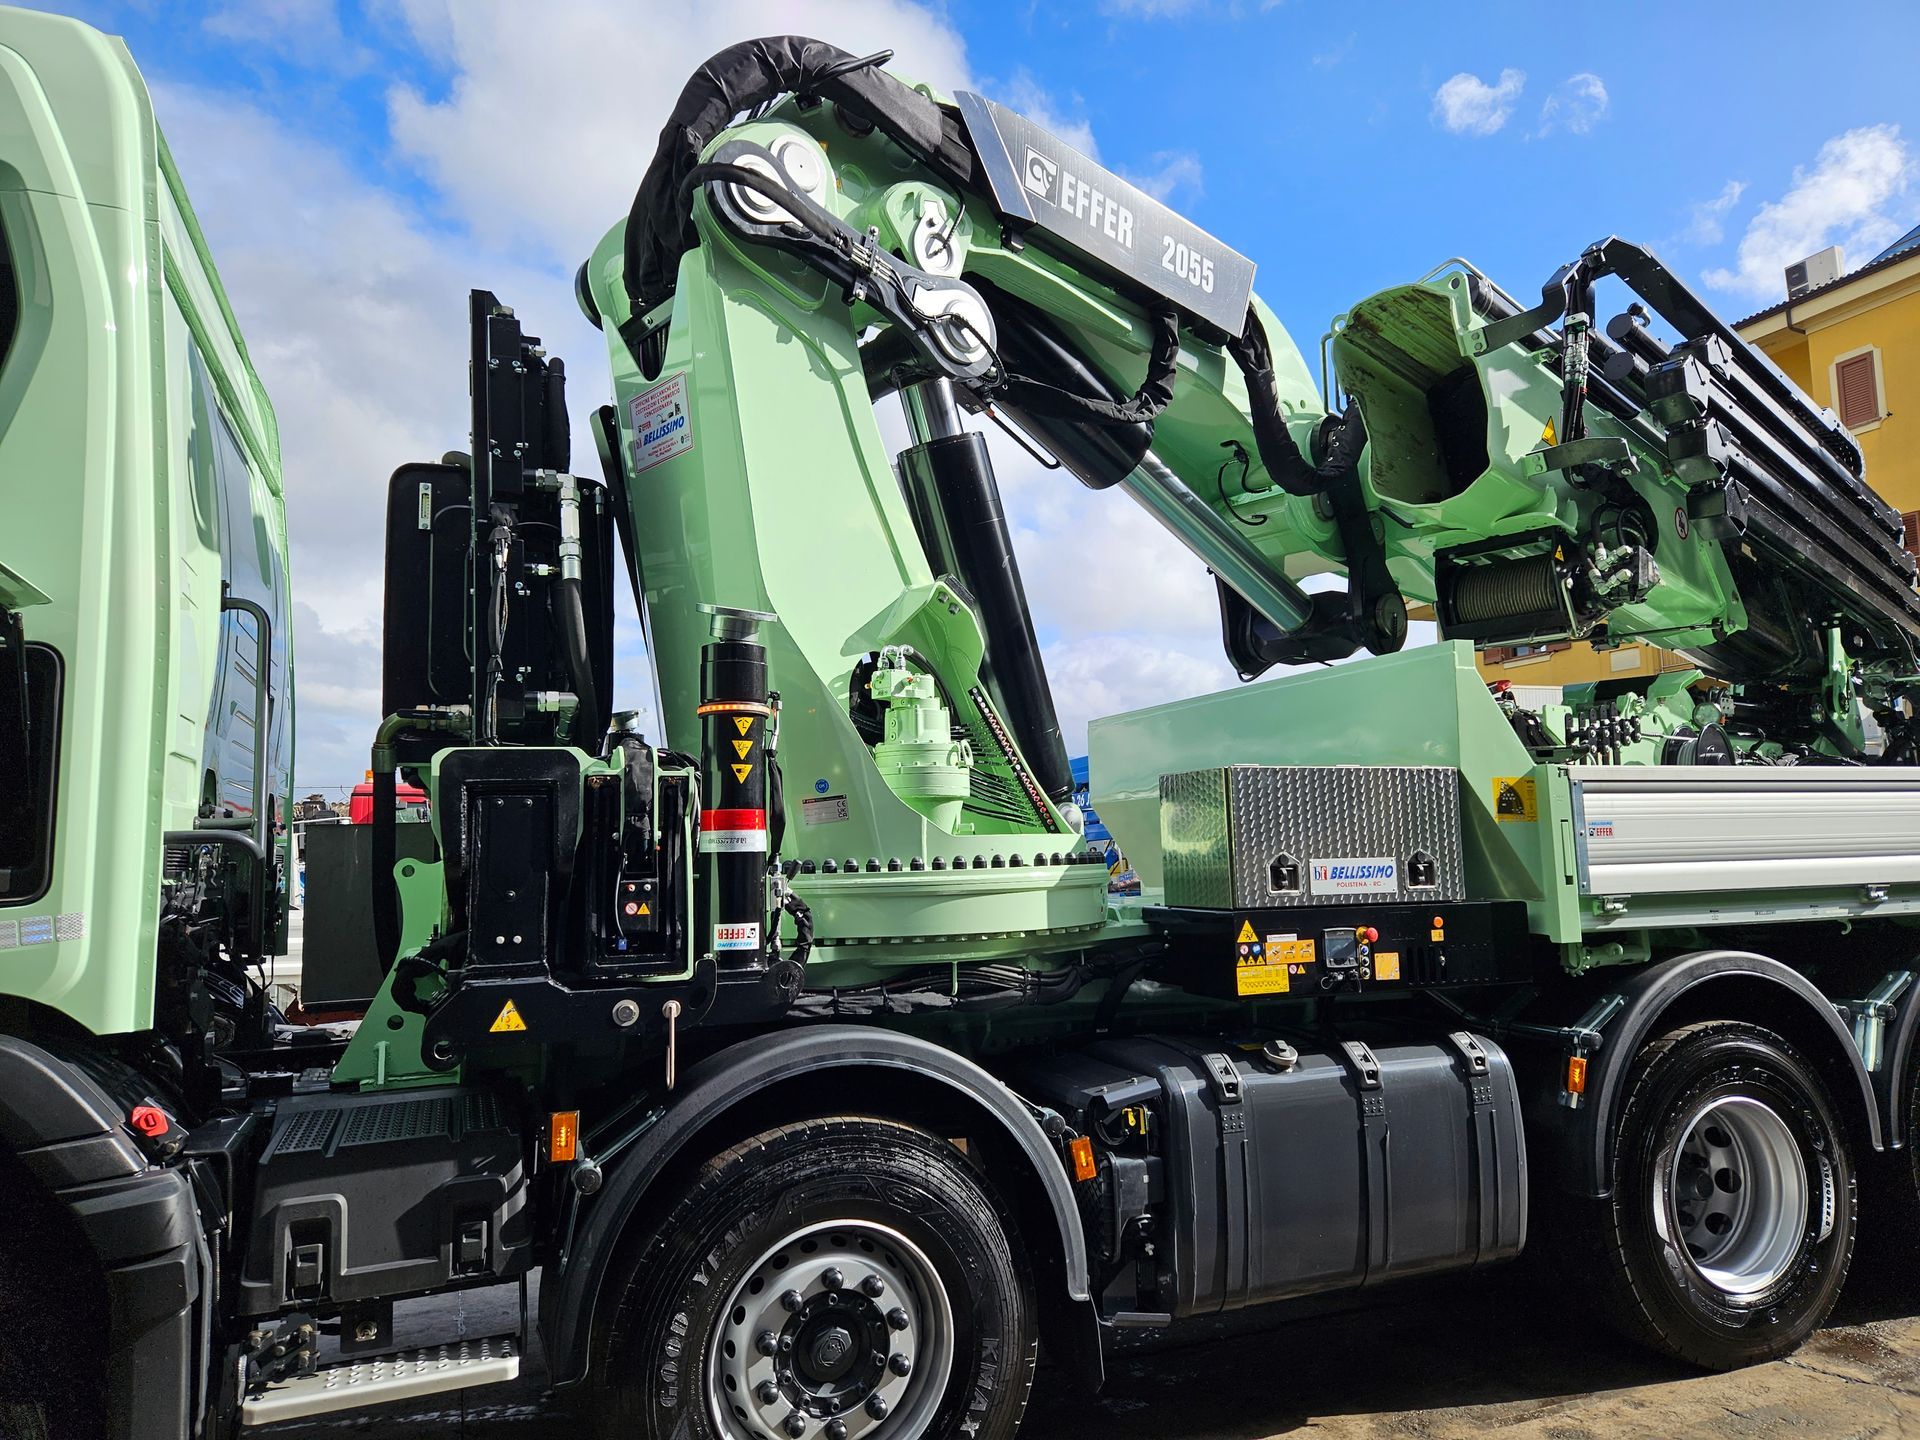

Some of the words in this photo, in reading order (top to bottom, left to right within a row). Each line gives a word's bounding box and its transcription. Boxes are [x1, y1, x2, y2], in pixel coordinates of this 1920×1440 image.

[1061, 171, 1134, 248] EFFER
[1161, 235, 1215, 294] 2055
[643, 415, 685, 446] BELLISSIMO
[1596, 828, 1613, 836] EFFER
[1330, 865, 1394, 880] BELLISSIMO
[717, 928, 745, 940] EFFER
